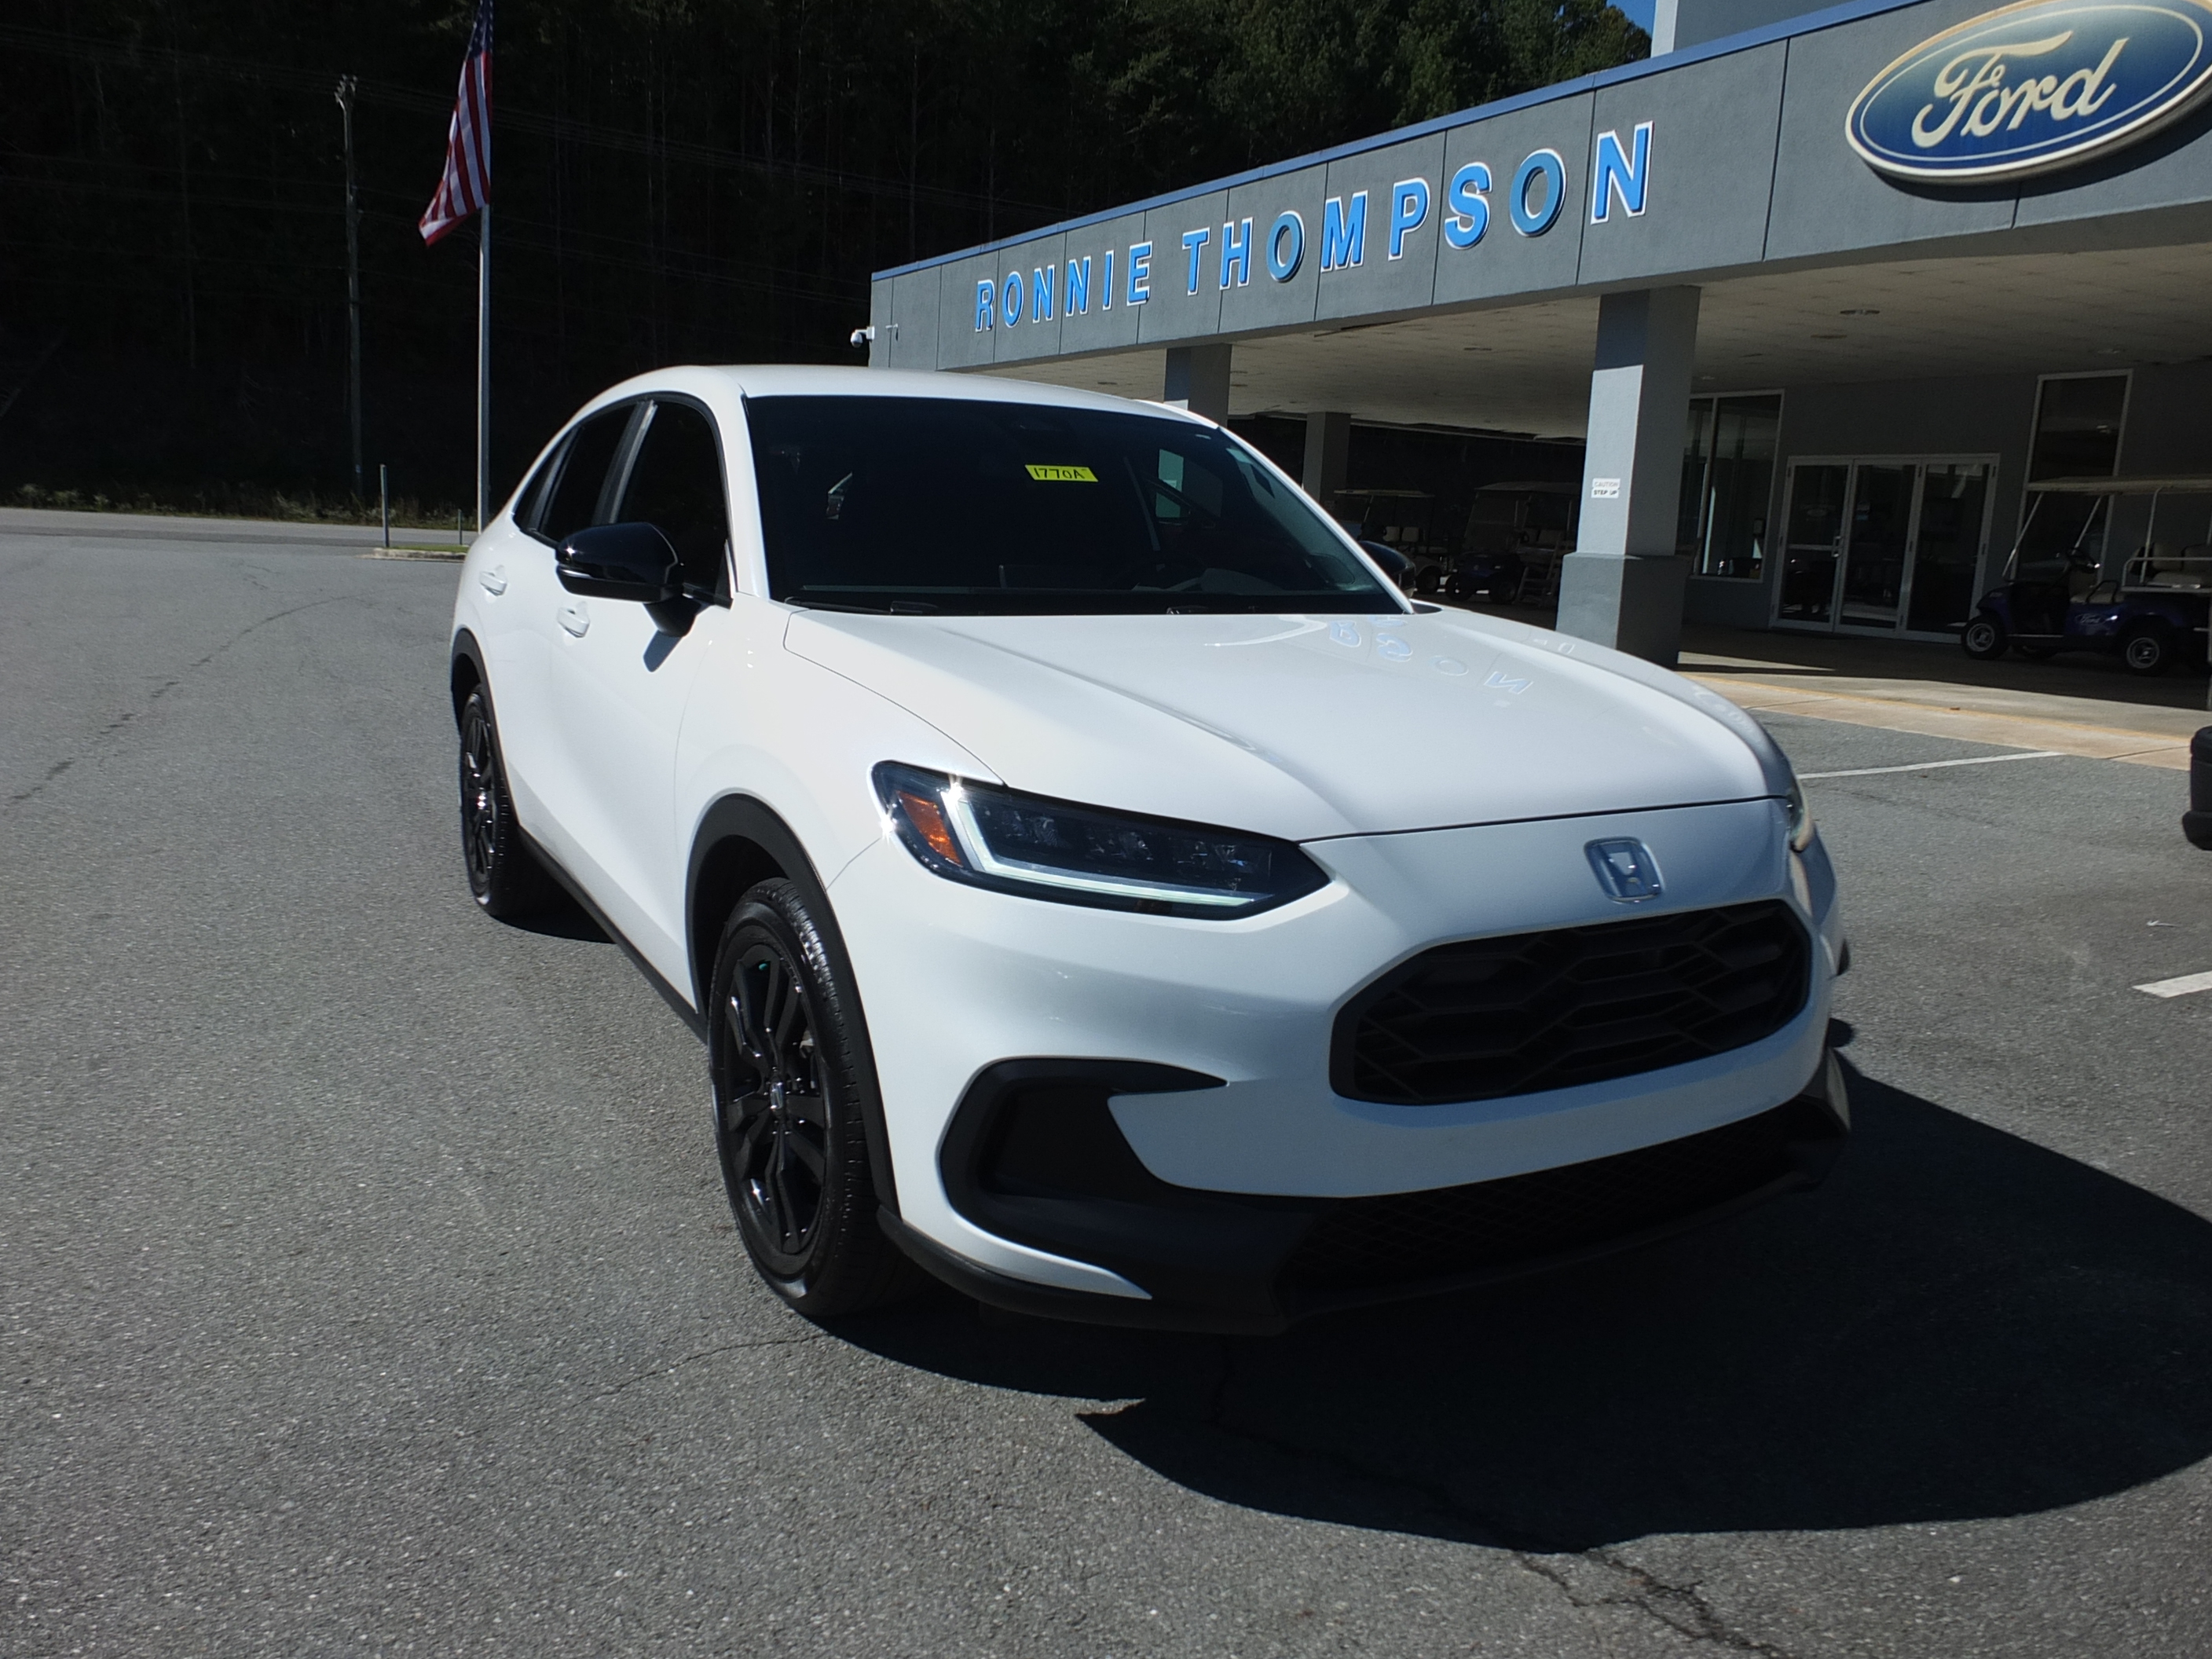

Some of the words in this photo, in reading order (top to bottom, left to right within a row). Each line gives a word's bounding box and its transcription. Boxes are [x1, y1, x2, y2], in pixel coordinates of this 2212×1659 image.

[1911, 30, 2130, 148] Ford
[975, 240, 1152, 332] RONNIE
[1182, 120, 1654, 296] THOMPSON
